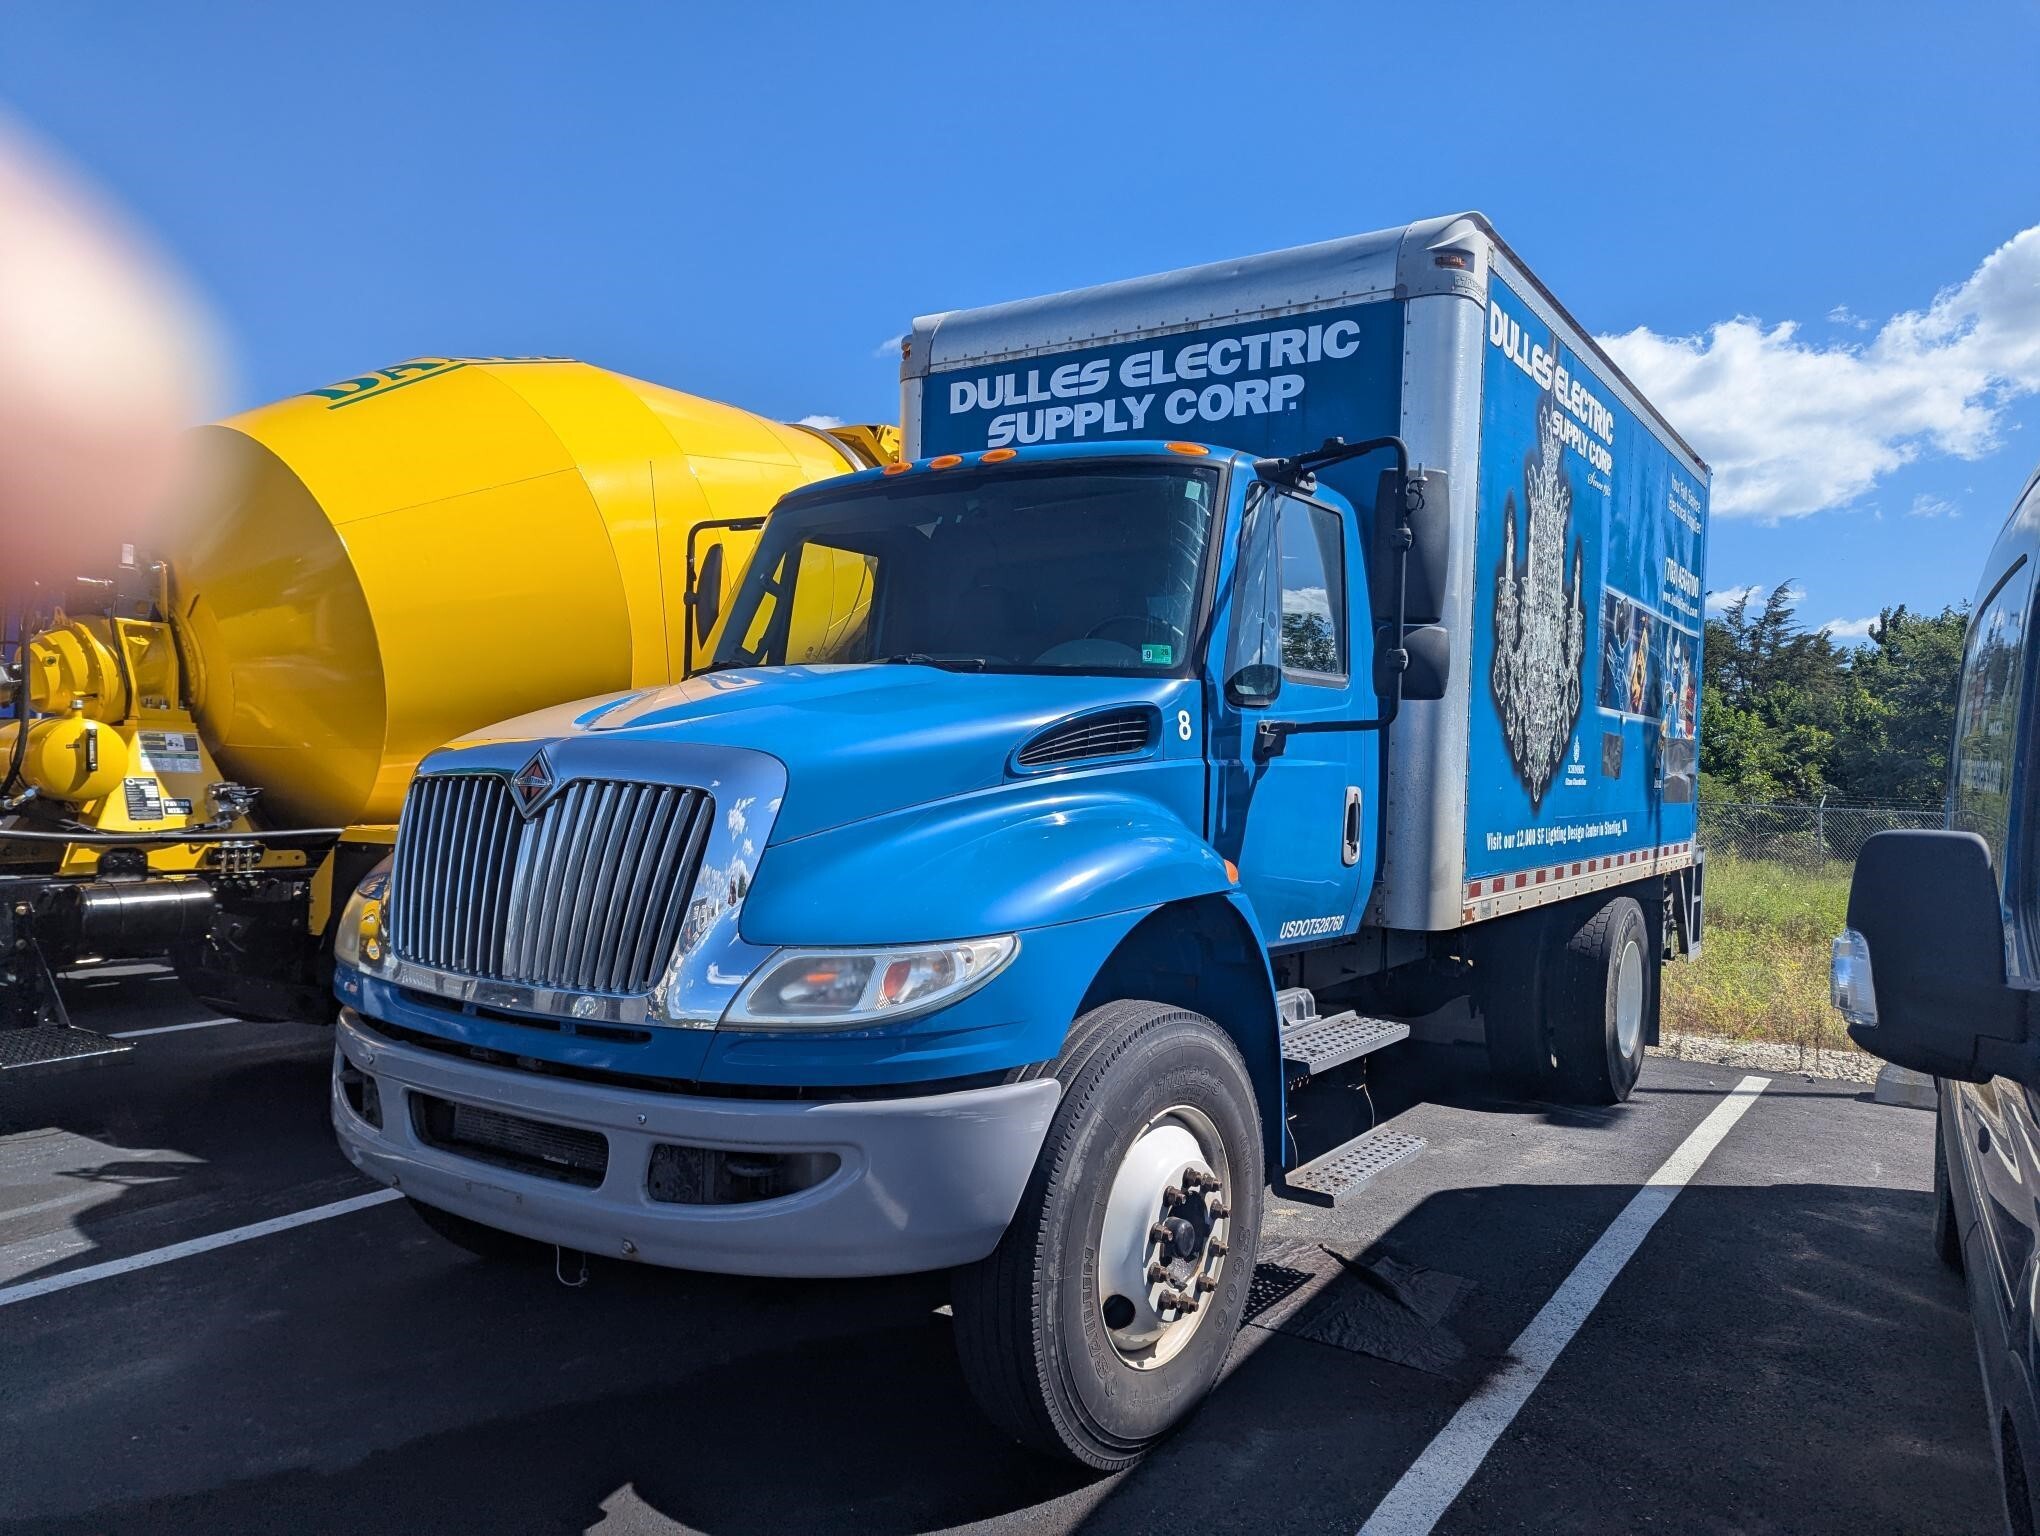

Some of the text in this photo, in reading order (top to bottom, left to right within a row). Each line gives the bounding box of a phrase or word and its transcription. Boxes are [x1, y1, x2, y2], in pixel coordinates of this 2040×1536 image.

[949, 319, 1361, 414] DULLES ELECTRIC
[1489, 300, 1614, 446] DULLES ELECTRIC
[987, 374, 1306, 448] SUPPLY CORP.
[1551, 410, 1589, 458] SUPPLY
[1178, 709, 1192, 741] 8
[1486, 832, 1502, 851] Visit
[1503, 834, 1516, 849] our
[1537, 827, 1545, 845] SF
[1545, 826, 1567, 847] Lighting
[1567, 824, 1585, 842] Design
